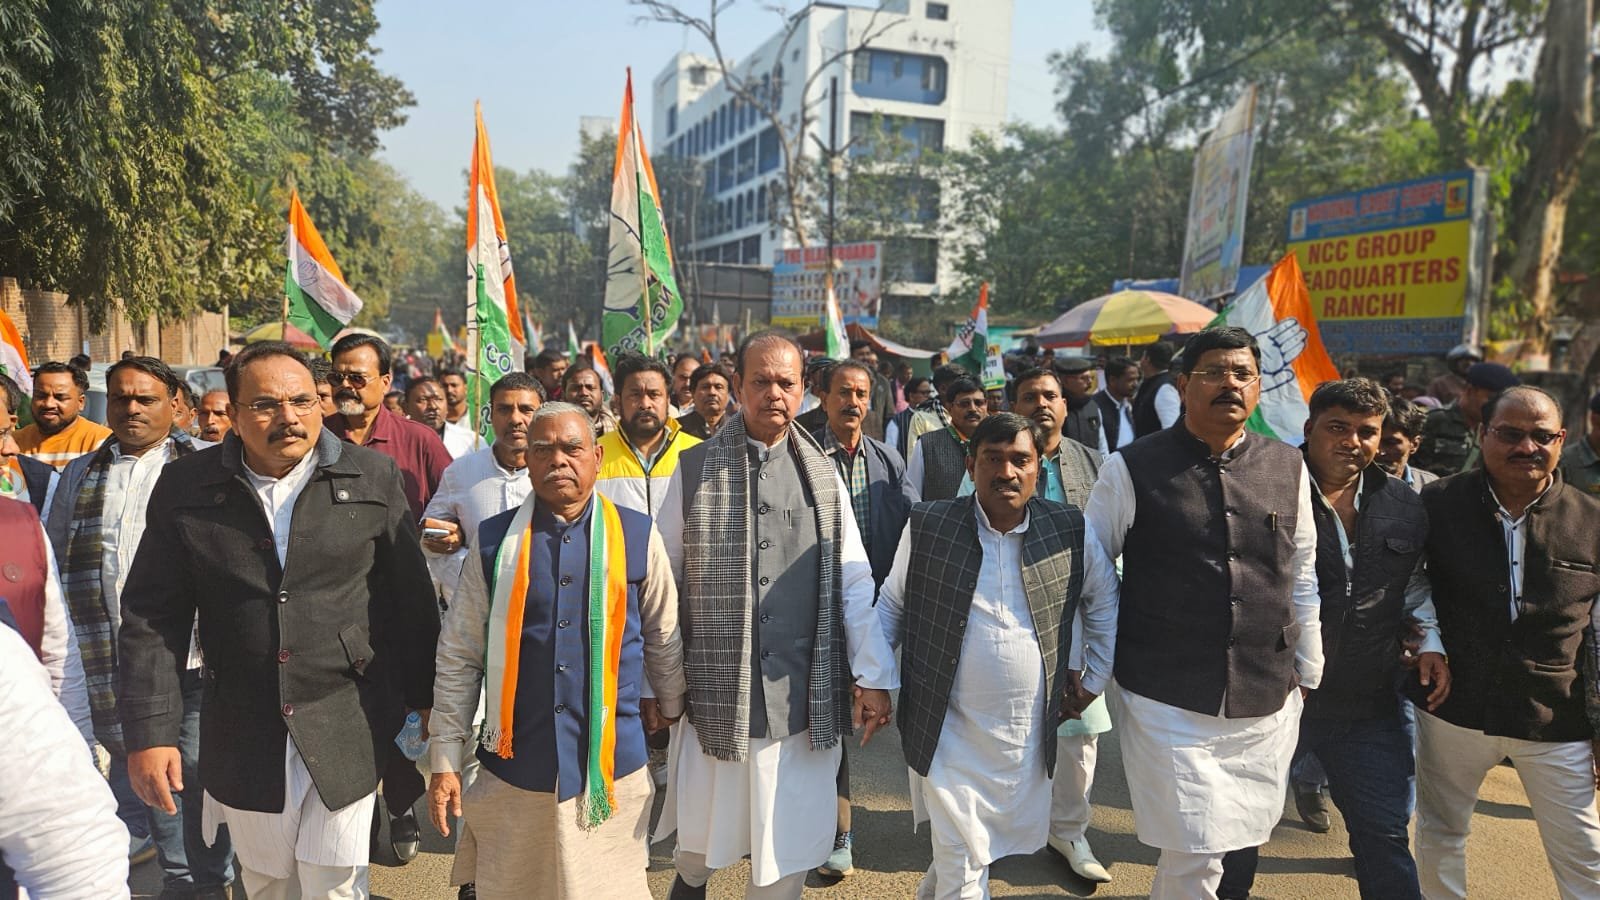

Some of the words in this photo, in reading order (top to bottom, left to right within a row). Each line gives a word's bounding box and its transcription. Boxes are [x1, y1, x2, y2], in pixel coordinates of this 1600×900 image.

[1308, 239, 1349, 265] NCC
[1356, 229, 1436, 260] GROUP
[1303, 256, 1460, 292] EADQUARTERS
[1323, 292, 1406, 318] RANCHI
